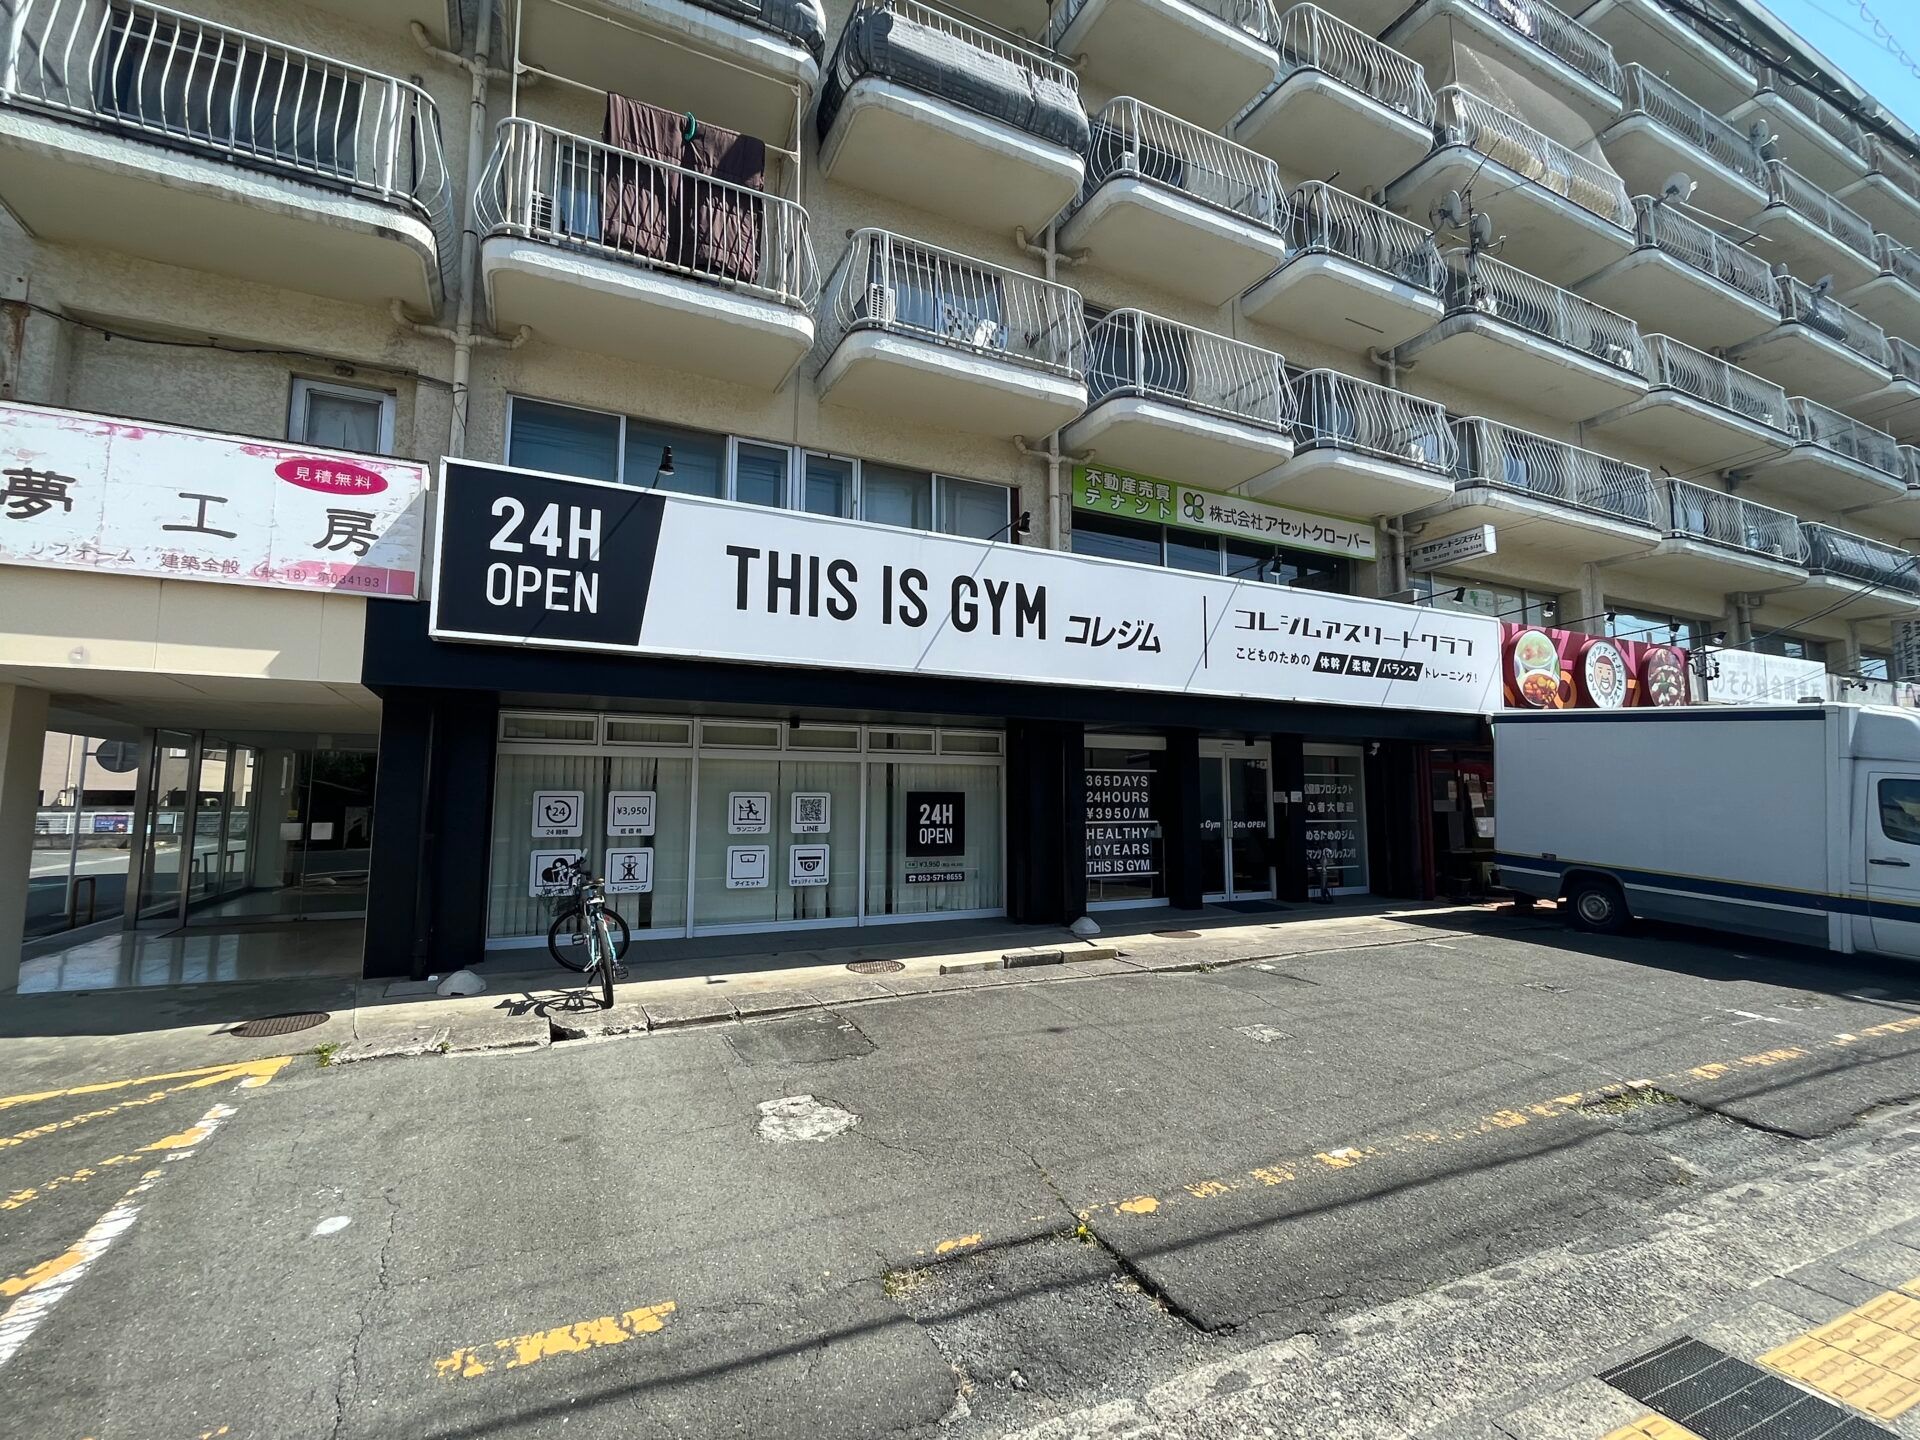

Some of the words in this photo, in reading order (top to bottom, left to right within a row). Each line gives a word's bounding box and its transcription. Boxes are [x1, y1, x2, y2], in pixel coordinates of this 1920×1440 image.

[295, 464, 372, 491] 見積無料
[1084, 468, 1171, 501] 不動産売買
[1085, 489, 1171, 518] テナント
[489, 496, 602, 561] 24H
[486, 562, 600, 614] OPEN
[726, 545, 858, 621] THIS
[882, 565, 928, 627] IS
[951, 575, 1047, 640] GYM
[1065, 615, 1162, 654] コレジム
[1236, 647, 1311, 666] こどものための
[1319, 655, 1341, 670] 体幹
[1351, 659, 1372, 673] 柔軟
[1382, 662, 1418, 678] バランス
[552, 807, 566, 817] 24
[617, 807, 648, 816] ¥3,950
[919, 803, 953, 825] 24H
[919, 828, 953, 844] OPEN
[1086, 827, 1149, 840] HEALTHY
[1087, 861, 1112, 873] THIS
[1114, 861, 1124, 872] IS
[1126, 859, 1150, 871] GYM
[611, 884, 647, 892] トレーニング
